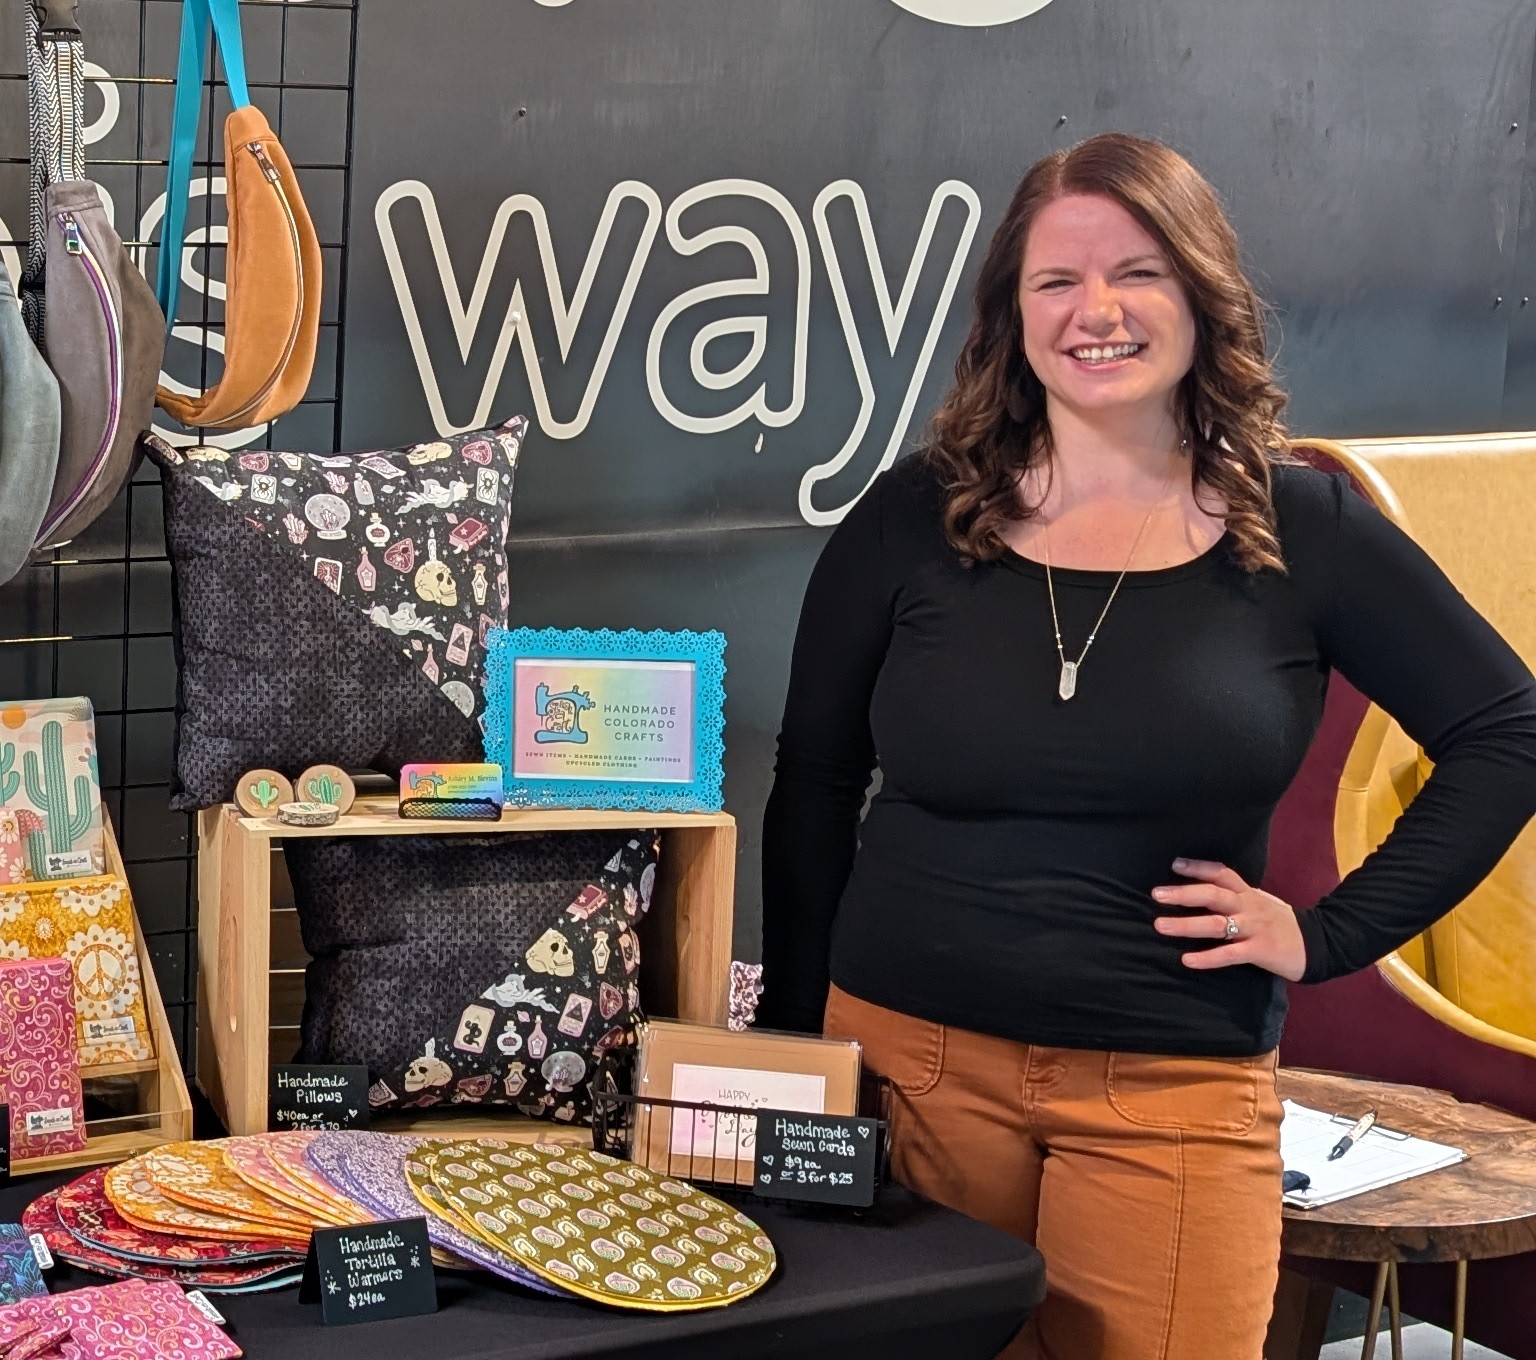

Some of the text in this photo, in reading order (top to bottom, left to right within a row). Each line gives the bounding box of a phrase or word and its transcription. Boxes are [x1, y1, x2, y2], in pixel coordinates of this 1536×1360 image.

[373, 178, 982, 530] way
[603, 704, 676, 716] HANDMADE
[604, 718, 675, 729] COLORADO
[614, 731, 664, 742] CRAFTS
[277, 1071, 349, 1088] Handmade
[296, 1088, 343, 1104] Pillows
[718, 1088, 751, 1100] HAPPY
[310, 1112, 324, 1121] or
[292, 1121, 340, 1131] 2 for $70
[775, 1118, 851, 1140] Handmade
[782, 1137, 856, 1156] Sewn Cards
[780, 1170, 854, 1186] or 3 for $25
[338, 1230, 405, 1254] Handmade
[344, 1252, 397, 1271] Tortilla
[347, 1268, 403, 1288] Warmers
